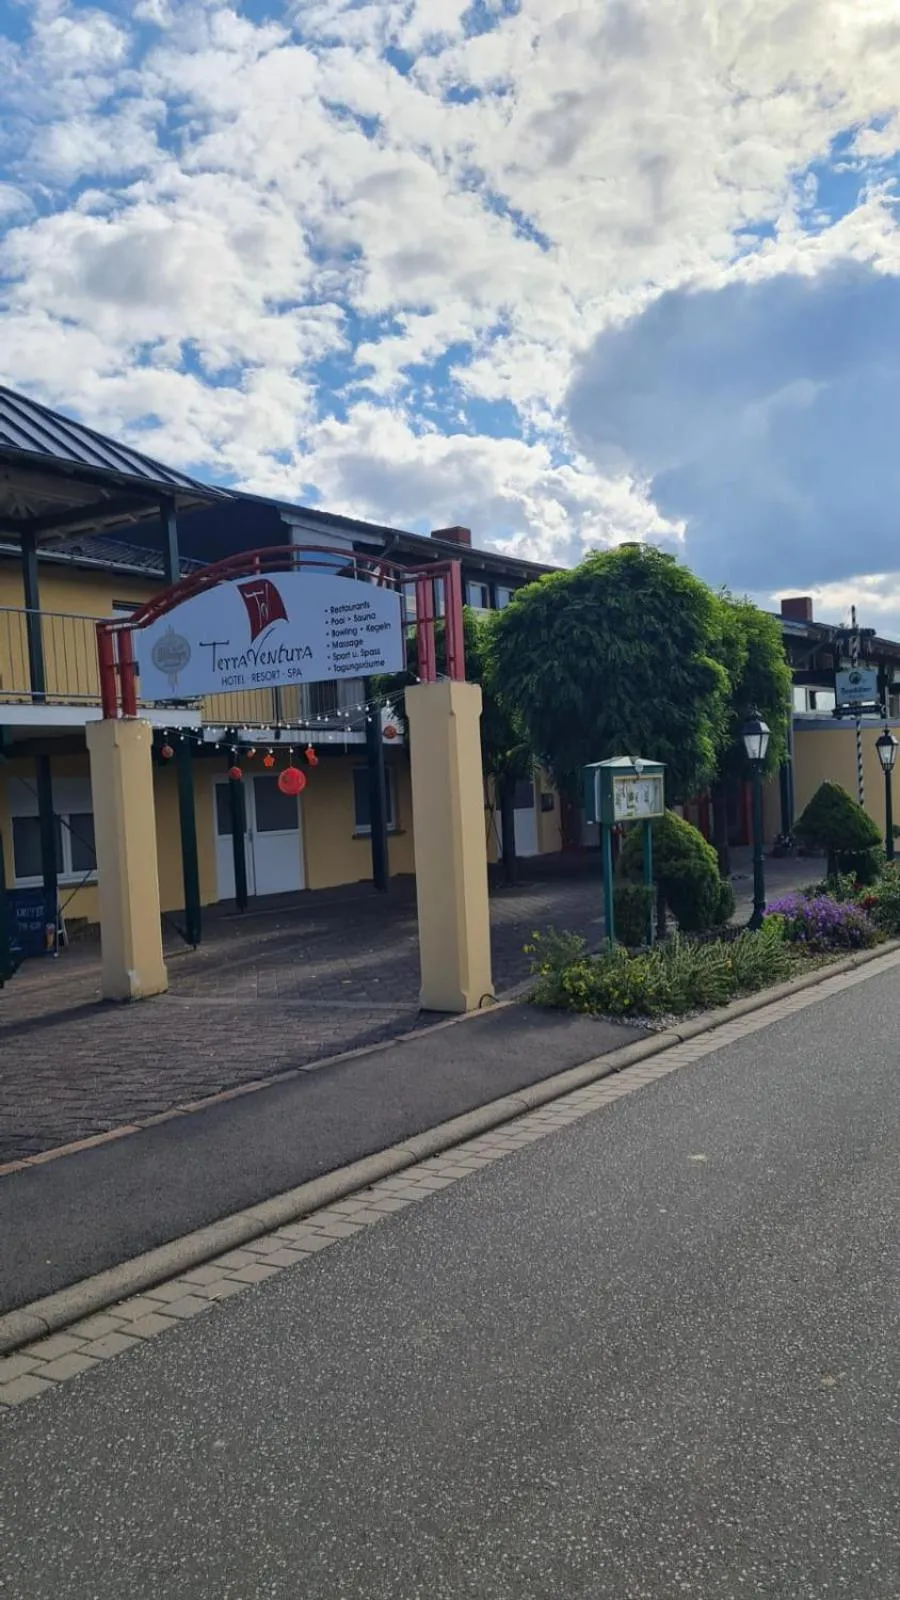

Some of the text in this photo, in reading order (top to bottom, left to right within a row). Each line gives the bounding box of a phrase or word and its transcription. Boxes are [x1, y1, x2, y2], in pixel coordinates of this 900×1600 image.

[329, 600, 370, 614] Restaurants
[330, 612, 376, 626] Pool Sauna
[331, 621, 391, 639] Bowling Kegeln
[199, 628, 313, 673] TerraVentura
[331, 638, 363, 650] Massage
[332, 651, 351, 662] Sport
[221, 667, 303, 687] HOTEL RESORT SPA
